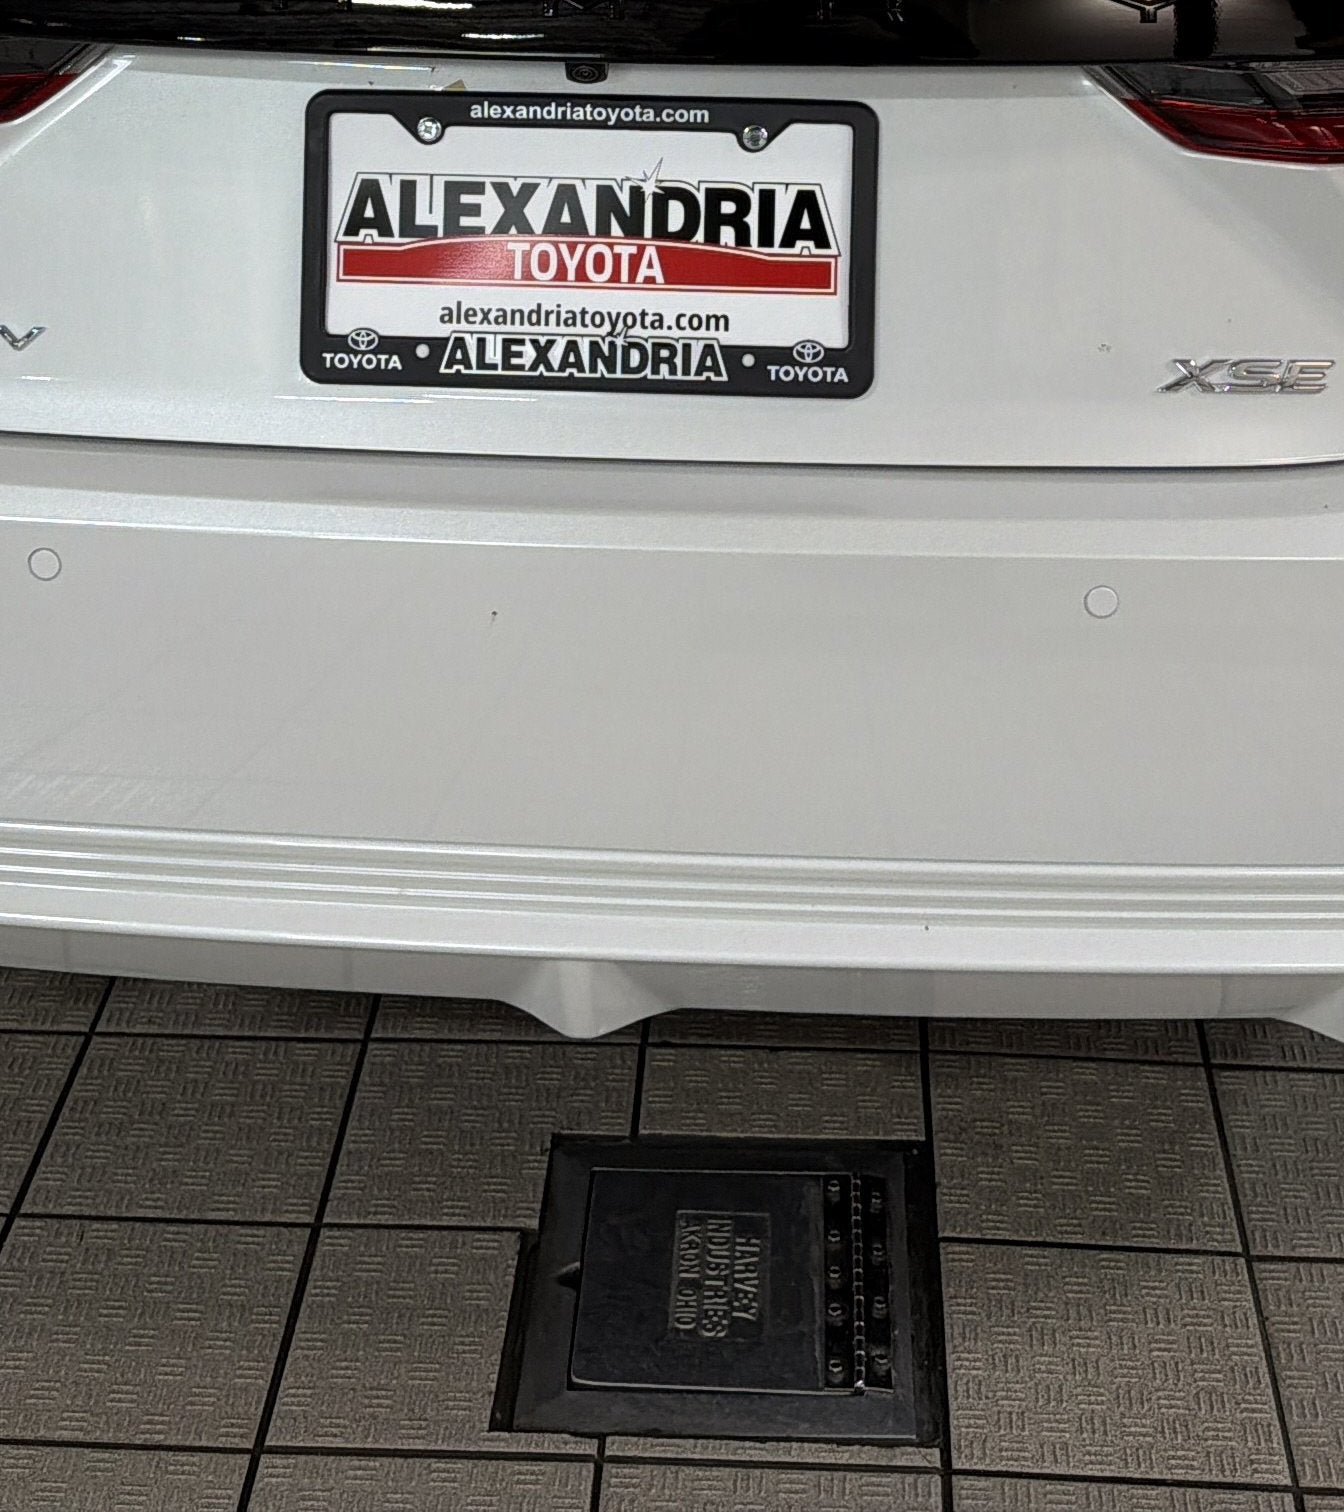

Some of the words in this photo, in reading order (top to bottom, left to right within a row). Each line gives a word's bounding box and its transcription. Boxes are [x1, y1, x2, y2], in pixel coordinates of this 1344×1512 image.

[469, 101, 711, 126] alexandriatoyota.com
[341, 176, 833, 251] ALEXANDRIA
[506, 241, 666, 285] TOYOTA
[438, 299, 731, 338] alexandriatoyota.com
[322, 352, 403, 371] TOYOTA
[441, 334, 728, 381] ALEXANDRIA
[766, 365, 850, 383] TOYOTA
[1156, 359, 1337, 394] XSE
[678, 1215, 702, 1278] AKRON
[701, 1218, 732, 1338] INDUSTRIES
[732, 1237, 760, 1321] HARVEY
[674, 1289, 698, 1330] OHIO
